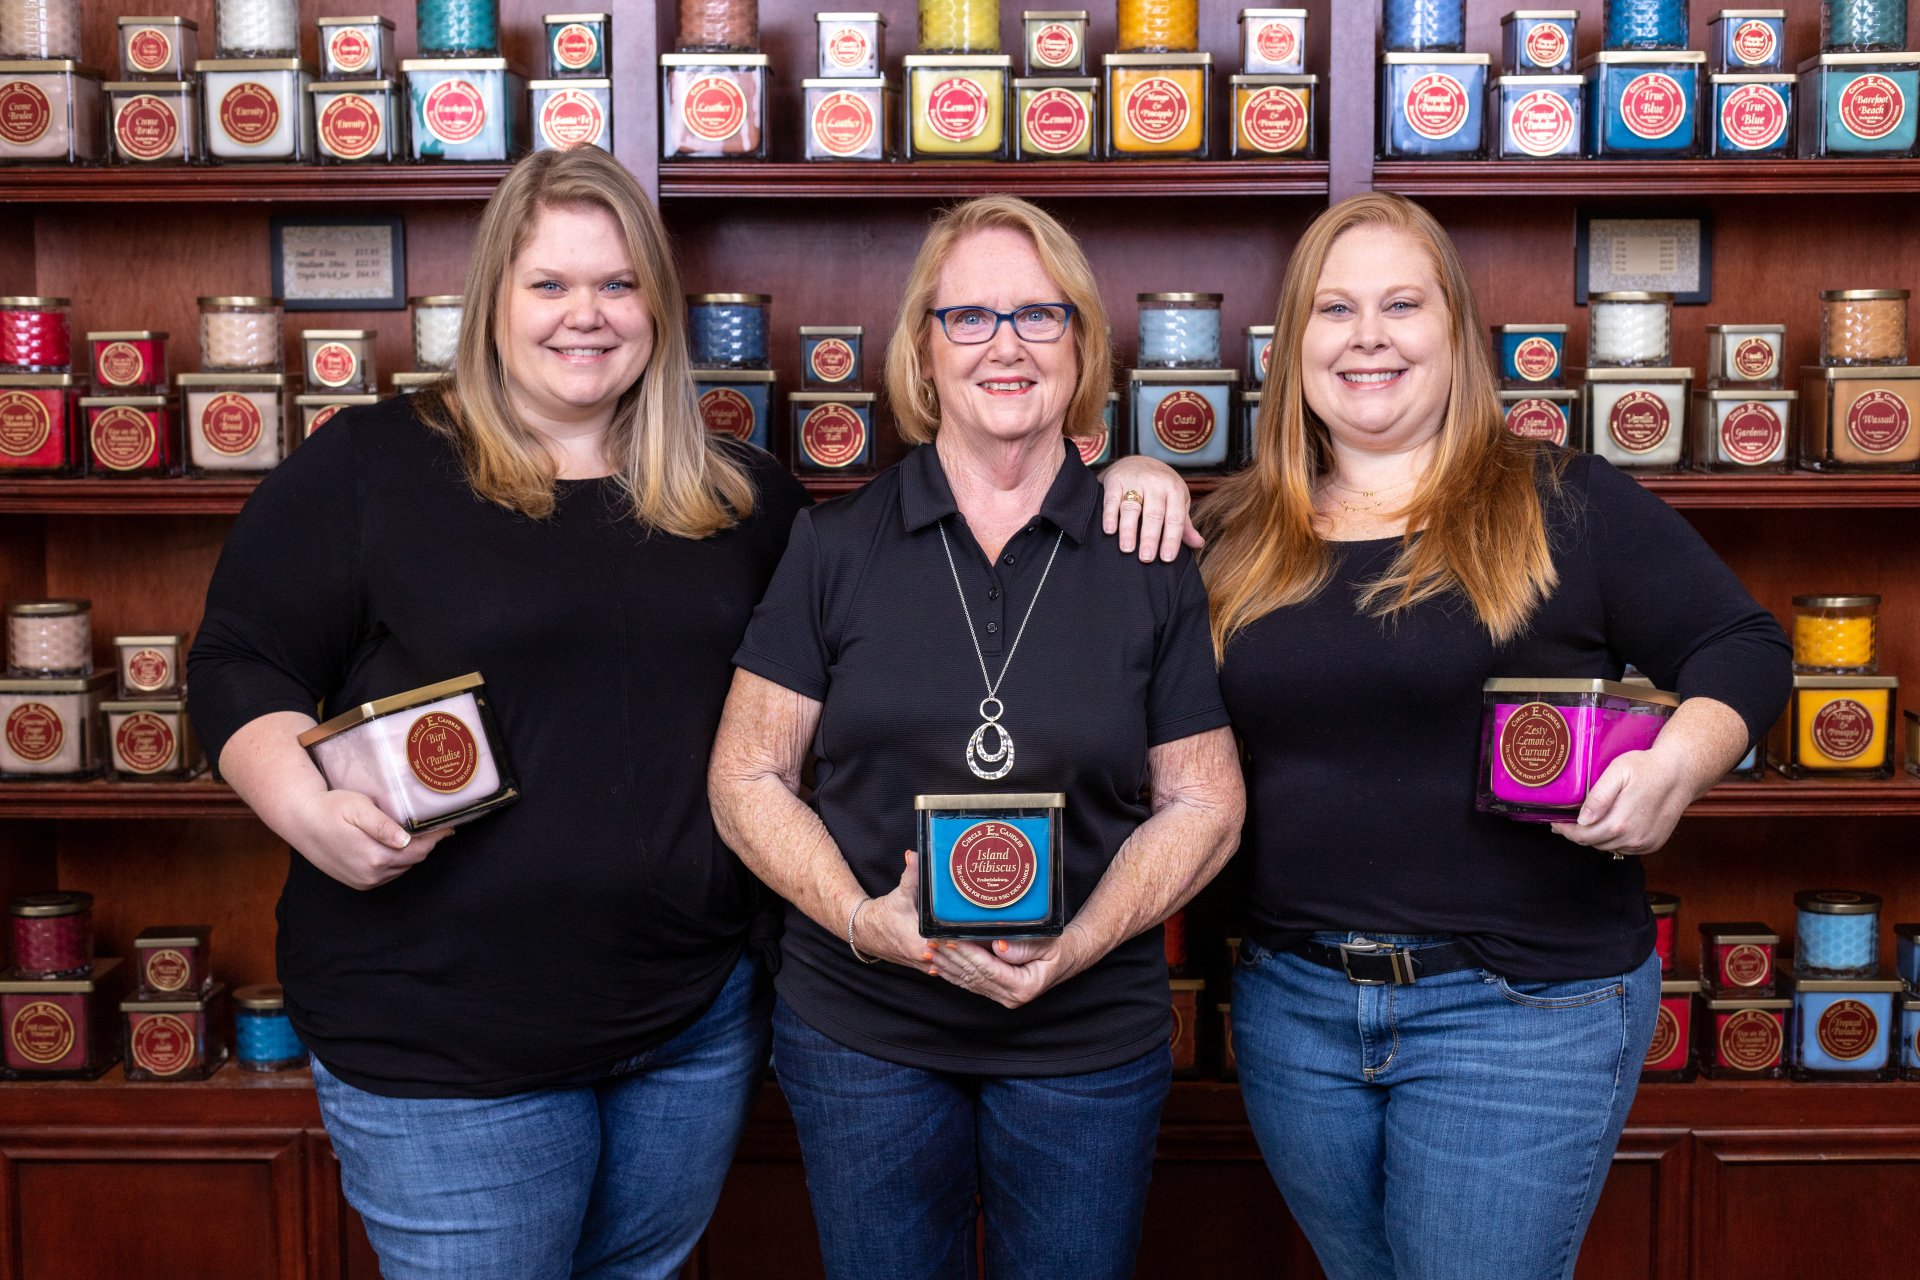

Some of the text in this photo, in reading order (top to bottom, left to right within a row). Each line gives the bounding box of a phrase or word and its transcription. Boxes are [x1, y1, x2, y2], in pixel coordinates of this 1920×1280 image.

[1849, 81, 1864, 94] CIRCLE
[1877, 78, 1895, 94] CANDLES
[1145, 93, 1169, 104] Mango
[1421, 92, 1451, 105] Tropical
[1641, 89, 1665, 101] True
[1855, 94, 1889, 106] Barefoot
[697, 101, 731, 112] Leather
[941, 100, 974, 112] Lemon
[1262, 102, 1286, 112] Mango
[1419, 103, 1452, 113] Paradise
[1641, 102, 1665, 114] Blue
[1741, 100, 1765, 112] True
[1858, 105, 1884, 114] Beach
[235, 107, 264, 118] Eternity
[1039, 112, 1073, 124] Lemon
[1141, 109, 1173, 120] Pineapple
[336, 120, 366, 130] Eternity
[827, 117, 861, 128] Leather
[1258, 118, 1291, 129] Pineapple
[1741, 113, 1765, 125] Blue
[1856, 396, 1872, 410] CIRCLE
[1884, 394, 1902, 410] CANDLES
[1173, 414, 1197, 425] Oasis
[1523, 416, 1548, 426] Island
[1862, 414, 1895, 424] Wassail
[1518, 427, 1552, 436] Hibiscus
[1734, 427, 1769, 440] Gardenia
[1511, 706, 1561, 729] CIRCLE E CANDLES
[411, 716, 461, 742] CIRCLE E CANDLES
[1524, 725, 1548, 739] Zesty
[427, 728, 447, 744] Bird
[1516, 736, 1554, 746] Lemon &
[437, 741, 444, 755] of
[1519, 746, 1551, 756] Currant
[427, 749, 461, 766] Paradise
[961, 825, 1024, 848] CIRCLE E CANDLES
[977, 848, 1009, 860] Island
[970, 861, 1017, 873] Hibiscus
